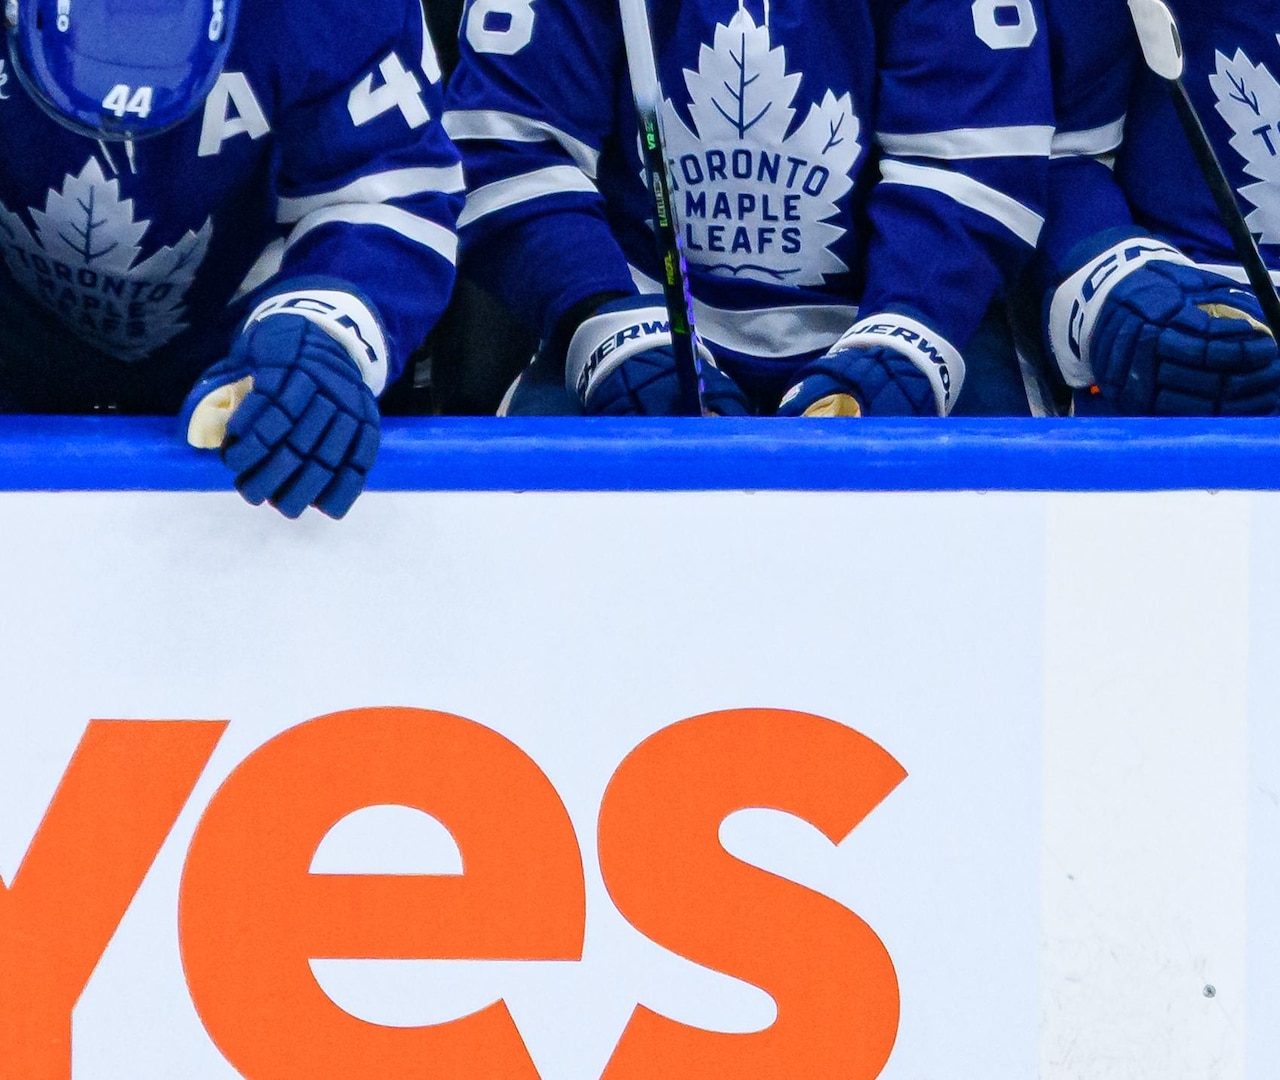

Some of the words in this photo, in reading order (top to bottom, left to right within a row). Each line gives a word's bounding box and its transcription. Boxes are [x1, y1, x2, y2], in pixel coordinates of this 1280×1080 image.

[102, 84, 152, 118] 44
[198, 71, 271, 157] A
[685, 191, 801, 222] MAPLE
[686, 225, 801, 254] LEAFS
[10, 245, 175, 303] TORONTO
